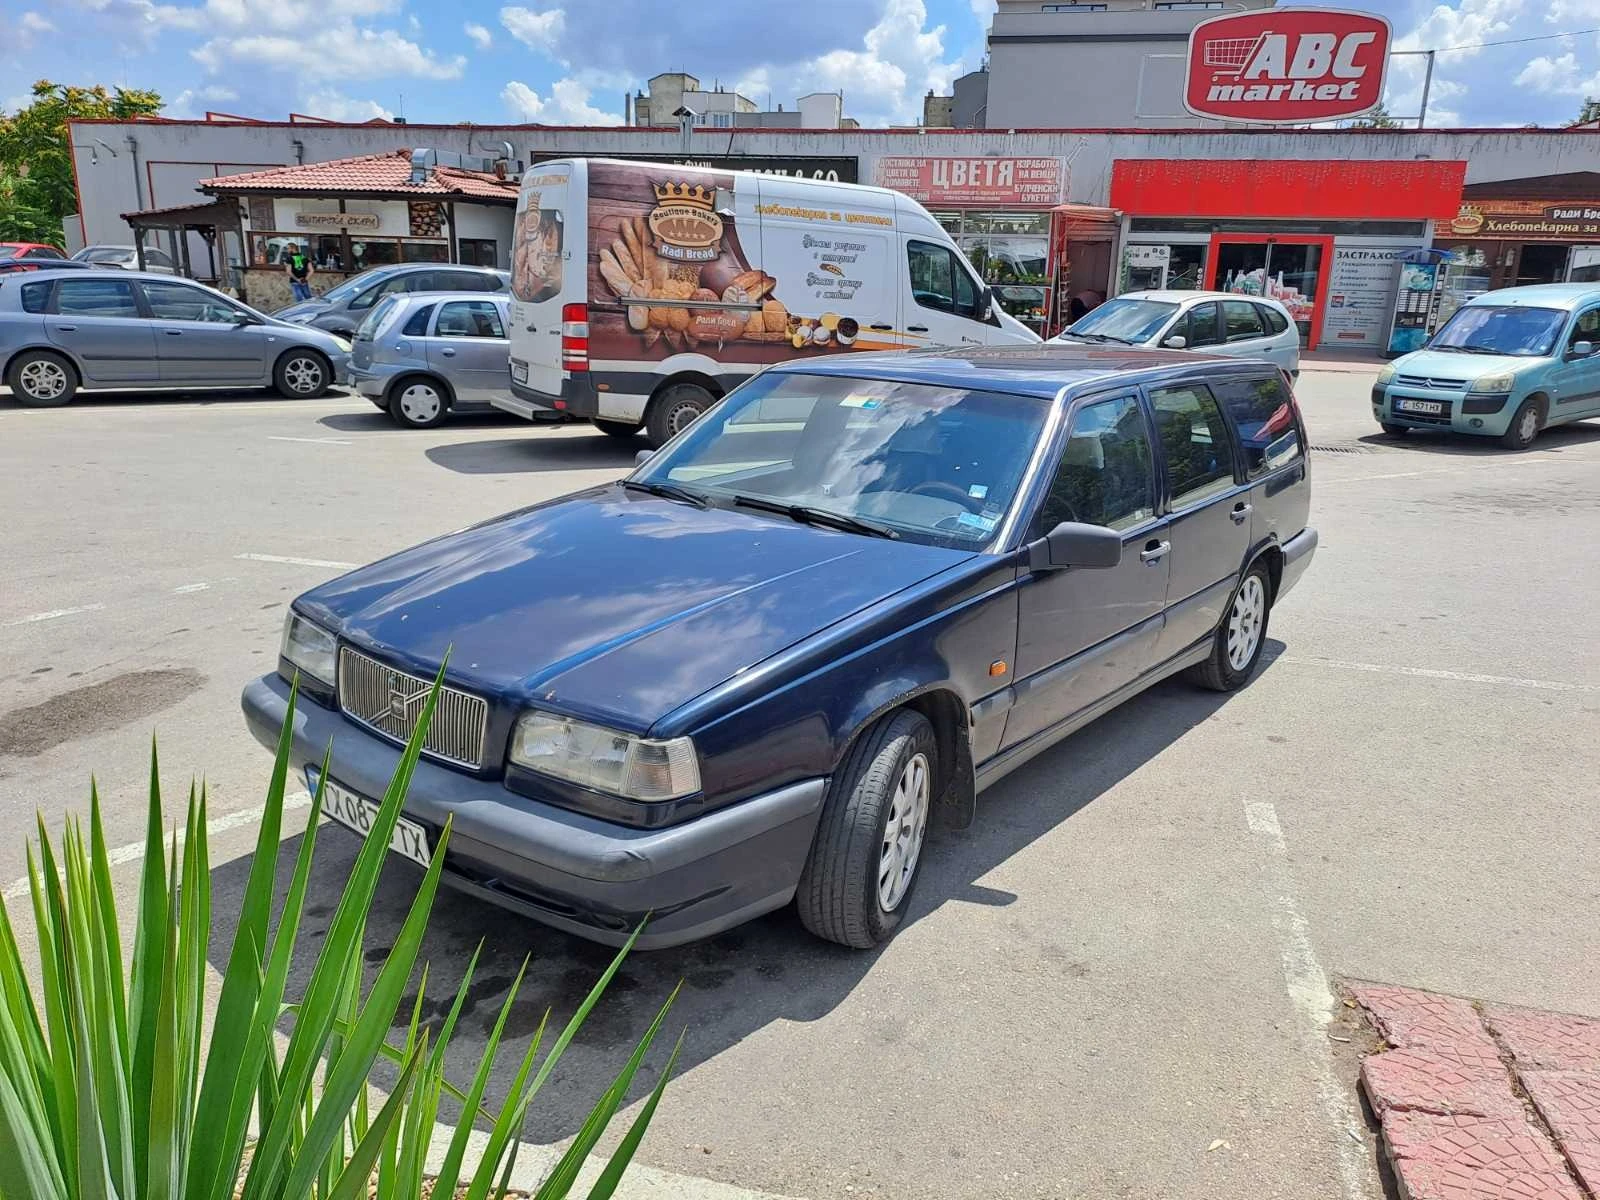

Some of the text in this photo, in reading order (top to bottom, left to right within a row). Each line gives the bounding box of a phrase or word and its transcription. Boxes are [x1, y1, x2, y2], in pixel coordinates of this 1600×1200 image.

[1243, 32, 1377, 80] ABC
[1206, 80, 1361, 101] market
[1016, 160, 1060, 169] ИЗРАБОТКА
[932, 159, 1014, 189] ЦВЕТЯ
[1018, 169, 1030, 178] НА
[1014, 184, 1058, 193] БУЛЧЕНСКИ
[1021, 193, 1050, 202] БУКЕТИ
[652, 208, 719, 226] Boutique Bakery
[1486, 220, 1598, 234] Хлебопекарна за
[662, 245, 714, 259] Radi Bread
